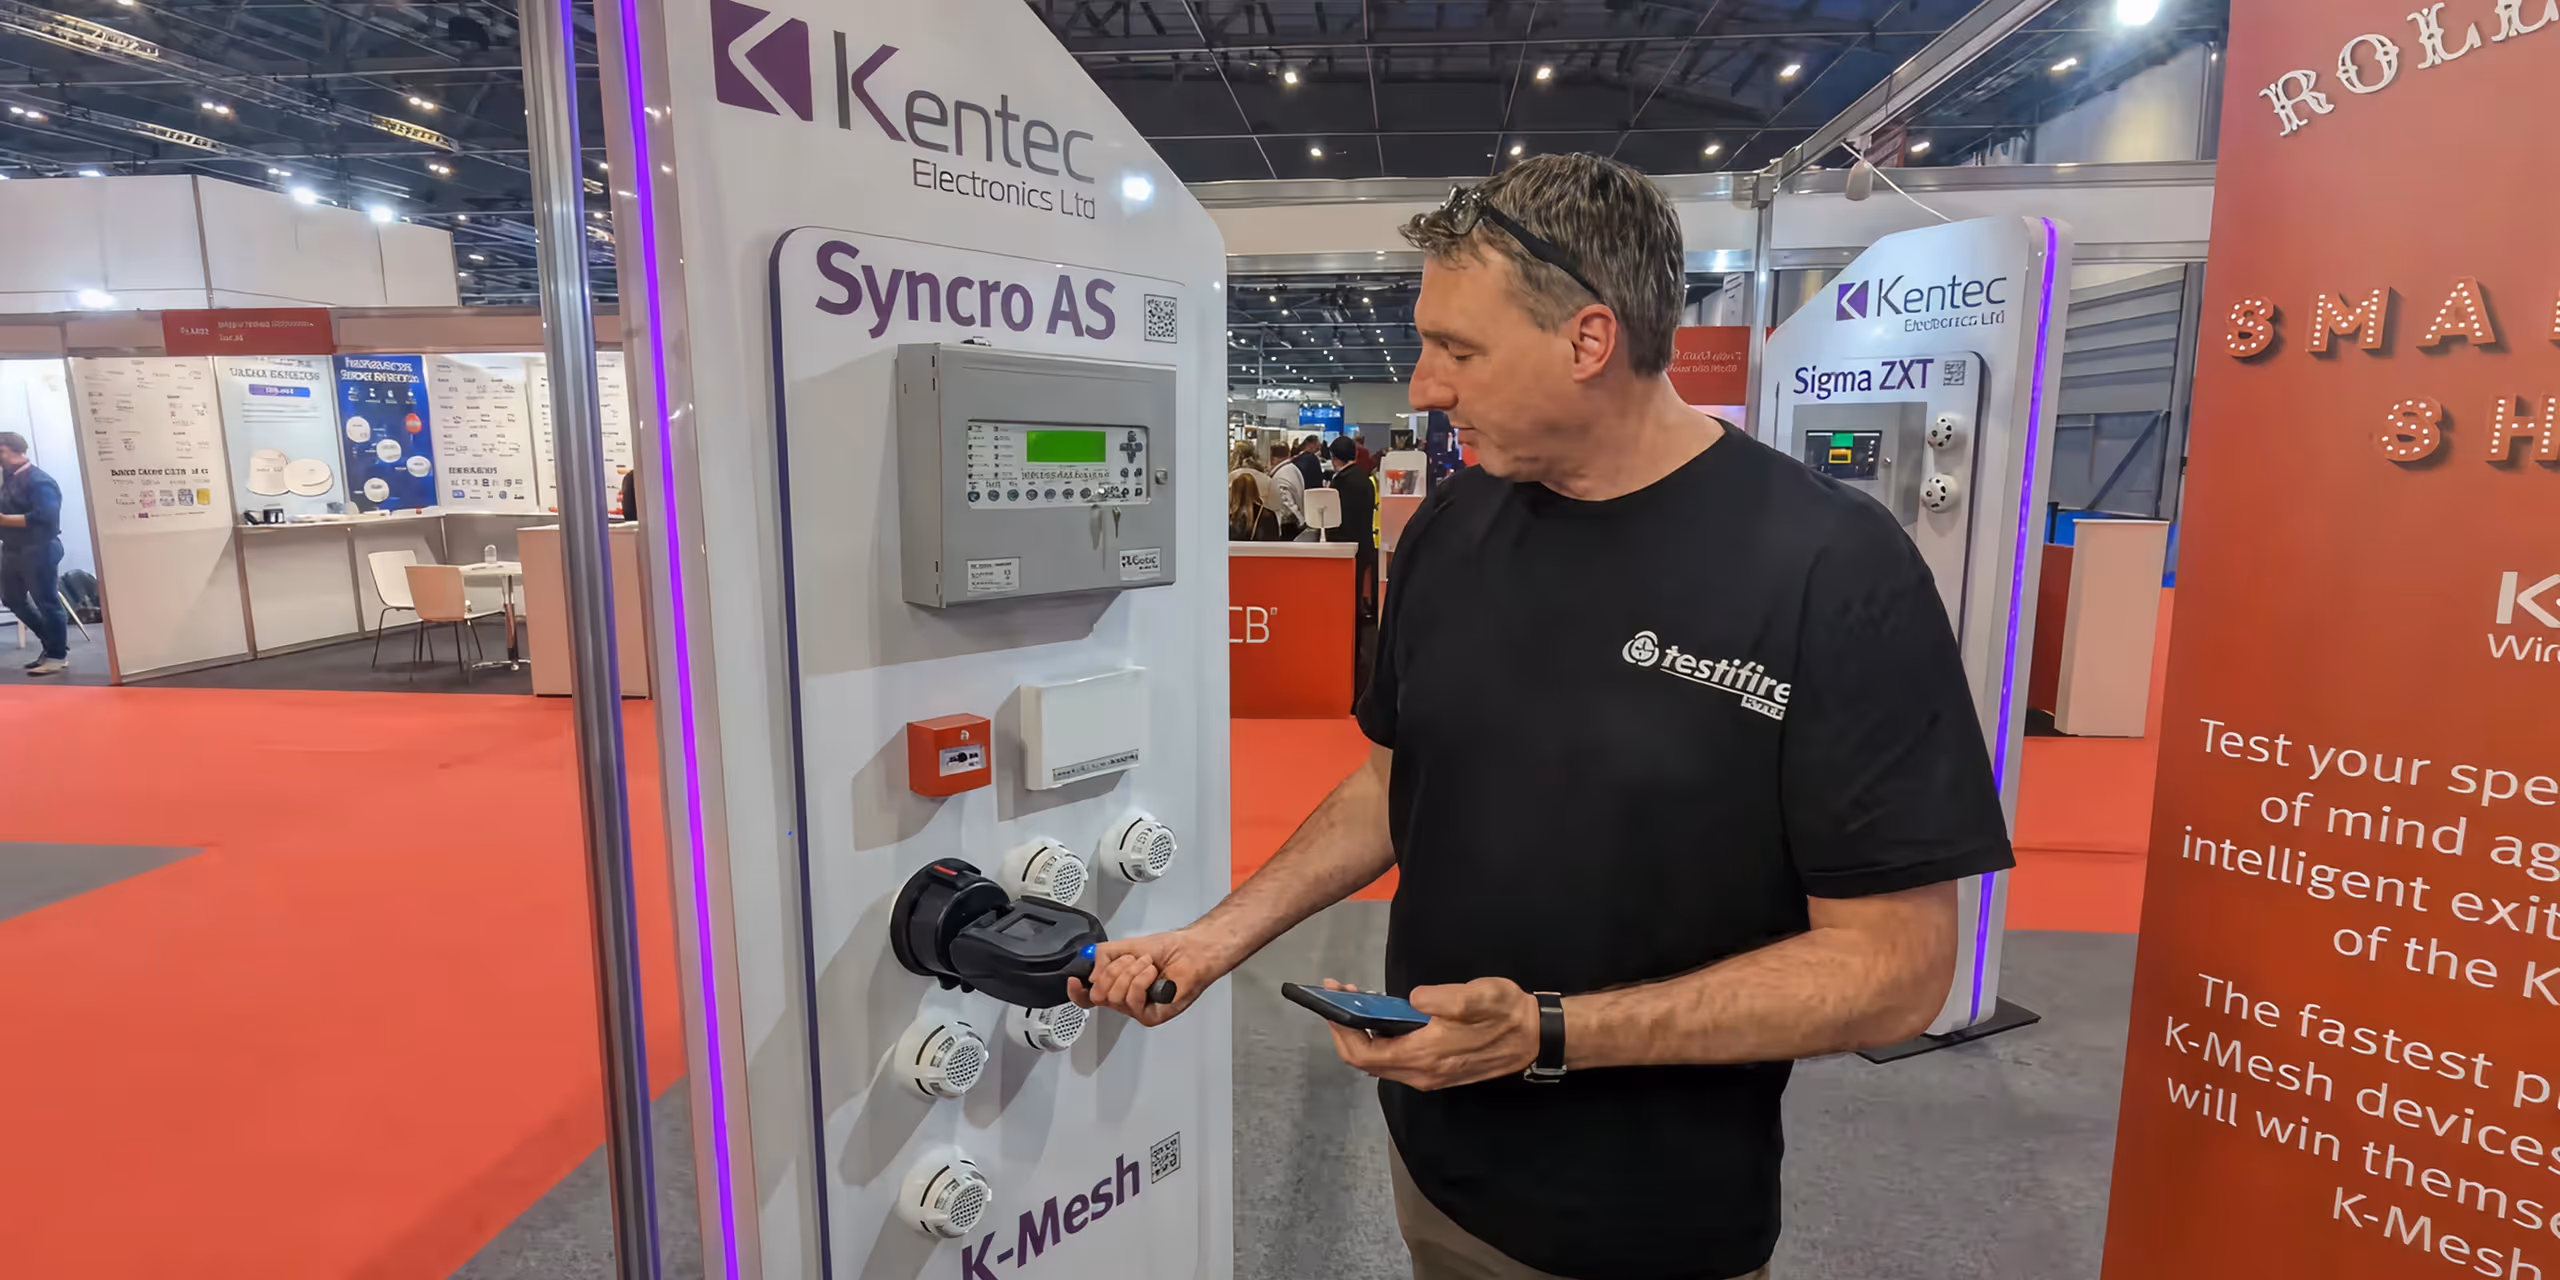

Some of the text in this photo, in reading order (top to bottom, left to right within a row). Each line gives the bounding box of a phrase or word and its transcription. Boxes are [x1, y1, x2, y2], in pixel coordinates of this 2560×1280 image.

[833, 30, 1096, 184] Kentec
[912, 158, 1096, 219] Electronics Ltd
[815, 240, 1116, 340] Syncro AS
[1876, 275, 2007, 317] Kentec
[2224, 276, 2560, 357] SMA
[1793, 358, 1934, 400] Sigma ZXT
[1661, 645, 1792, 704] testifire
[2488, 633, 2560, 662] Wir
[2200, 718, 2560, 807] Test your spe
[2260, 792, 2560, 882] of mind ag
[2183, 825, 2560, 942] intelligent exit
[2333, 926, 2392, 961] of
[2404, 937, 2498, 988] the
[2165, 1016, 2333, 1102] K-Mesh
[2199, 973, 2280, 1028] The
[2299, 1003, 2494, 1089] fastest
[2167, 1077, 2237, 1127] will
[2256, 1110, 2340, 1162] win
[960, 1153, 1140, 1280] K-Mesh
[2333, 1186, 2541, 1280] K-Mesh
